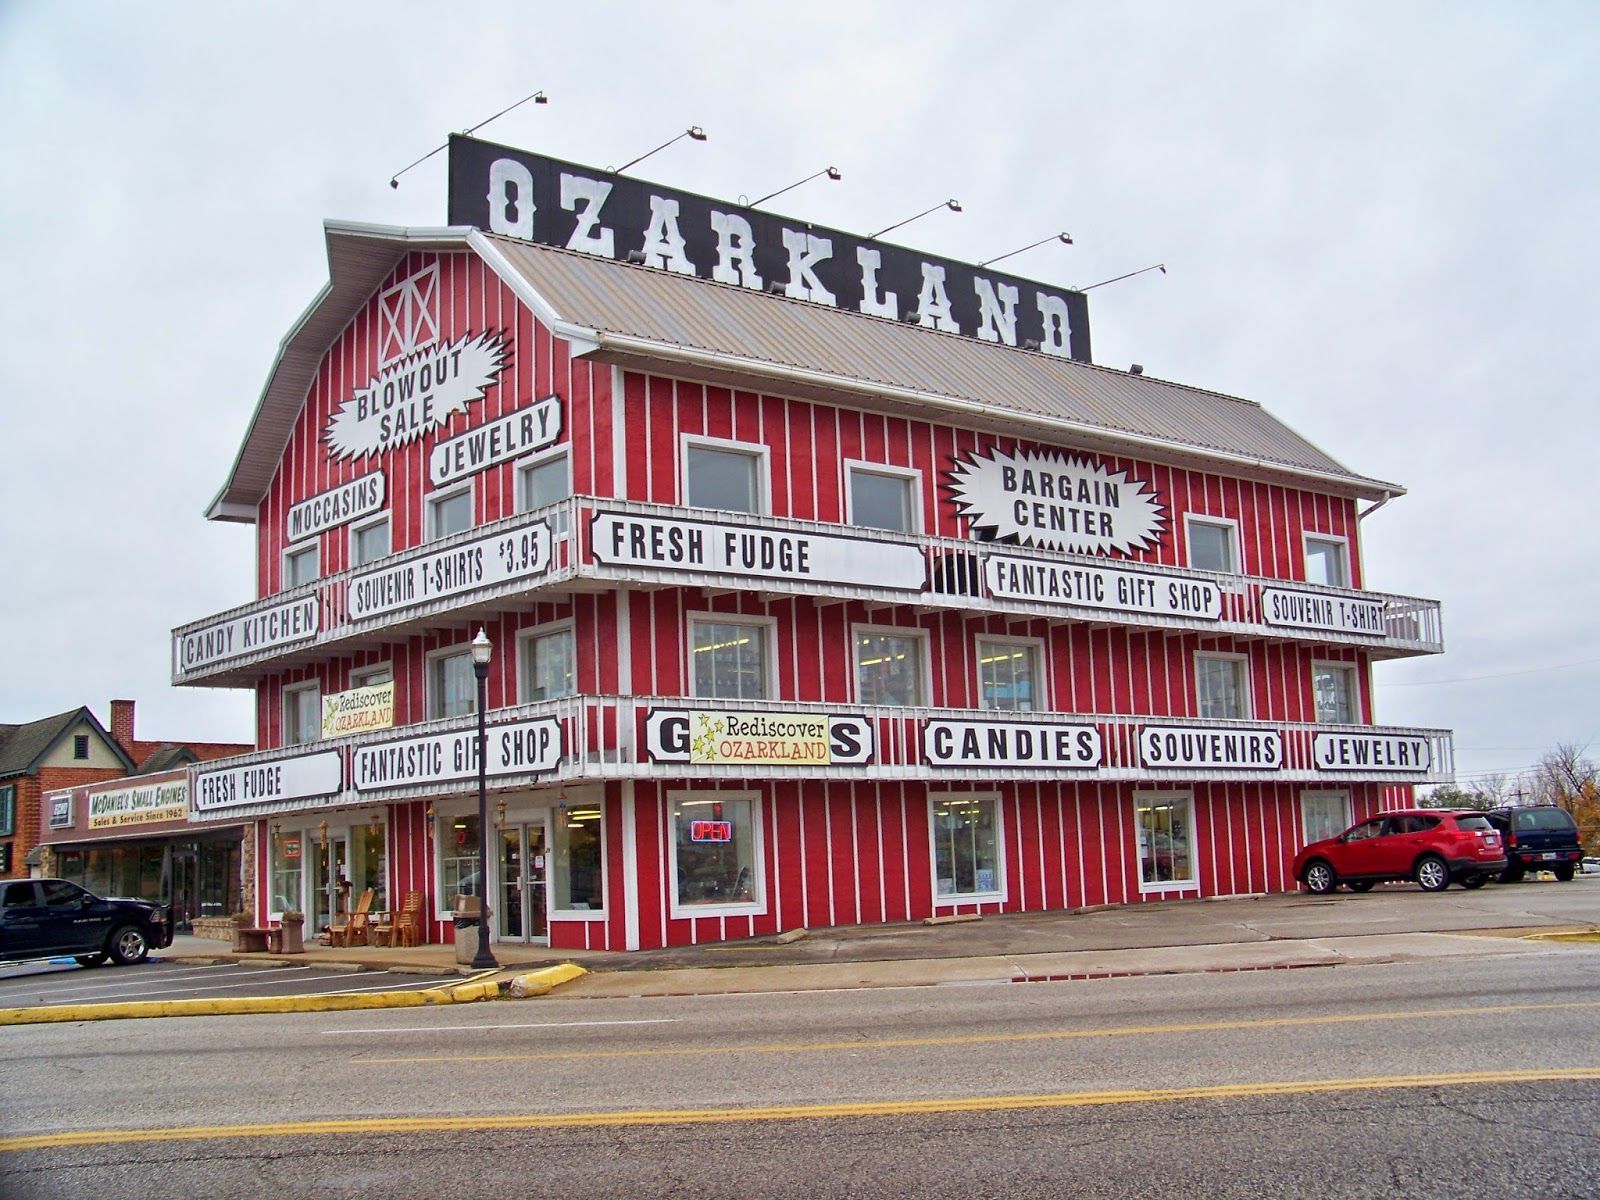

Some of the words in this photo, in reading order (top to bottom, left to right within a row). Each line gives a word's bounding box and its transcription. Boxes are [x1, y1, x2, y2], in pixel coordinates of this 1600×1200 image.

[487, 158, 1072, 357] OZARKLAND
[357, 350, 462, 422] BLOWOUT
[380, 394, 434, 443] SALE
[440, 406, 551, 478] JEWELRY
[293, 478, 378, 536] MOCCASINS
[1003, 466, 1120, 509] BARGAIN
[1014, 499, 1114, 538] CENTER
[611, 522, 703, 563] FRESH
[725, 533, 810, 573] FUDGE
[356, 571, 414, 613] SOUVENIR
[423, 547, 483, 597] T-SHIRTS
[499, 530, 539, 573] $3.95
[997, 561, 1104, 602] FANTASTIC
[1118, 579, 1155, 608] GIFT
[1169, 585, 1213, 614] SHOP
[1273, 593, 1335, 626] SOUVENIR
[186, 625, 234, 666] CANDY
[243, 606, 314, 648] KITCHEN
[335, 706, 392, 731] OZARKLAND
[340, 689, 392, 713] Rediscover
[726, 716, 824, 738] Rediscover
[934, 726, 1095, 761] CANDIES
[362, 742, 443, 784] FANTASTIC
[501, 726, 550, 768] SHOP
[719, 741, 827, 760] OZARKLAND
[1149, 732, 1275, 762] SOUVENIRS
[1324, 736, 1422, 766] JEWELRY
[131, 789, 154, 811] SMALL
[155, 785, 188, 808] ENGINES
[203, 770, 237, 805] FRESH
[244, 766, 282, 799] FUDGE
[94, 818, 110, 827] Sales
[112, 816, 118, 824] &
[120, 813, 144, 824] Service
[146, 810, 164, 820] Since
[166, 808, 183, 819] 1962
[693, 822, 730, 840] OPEN
